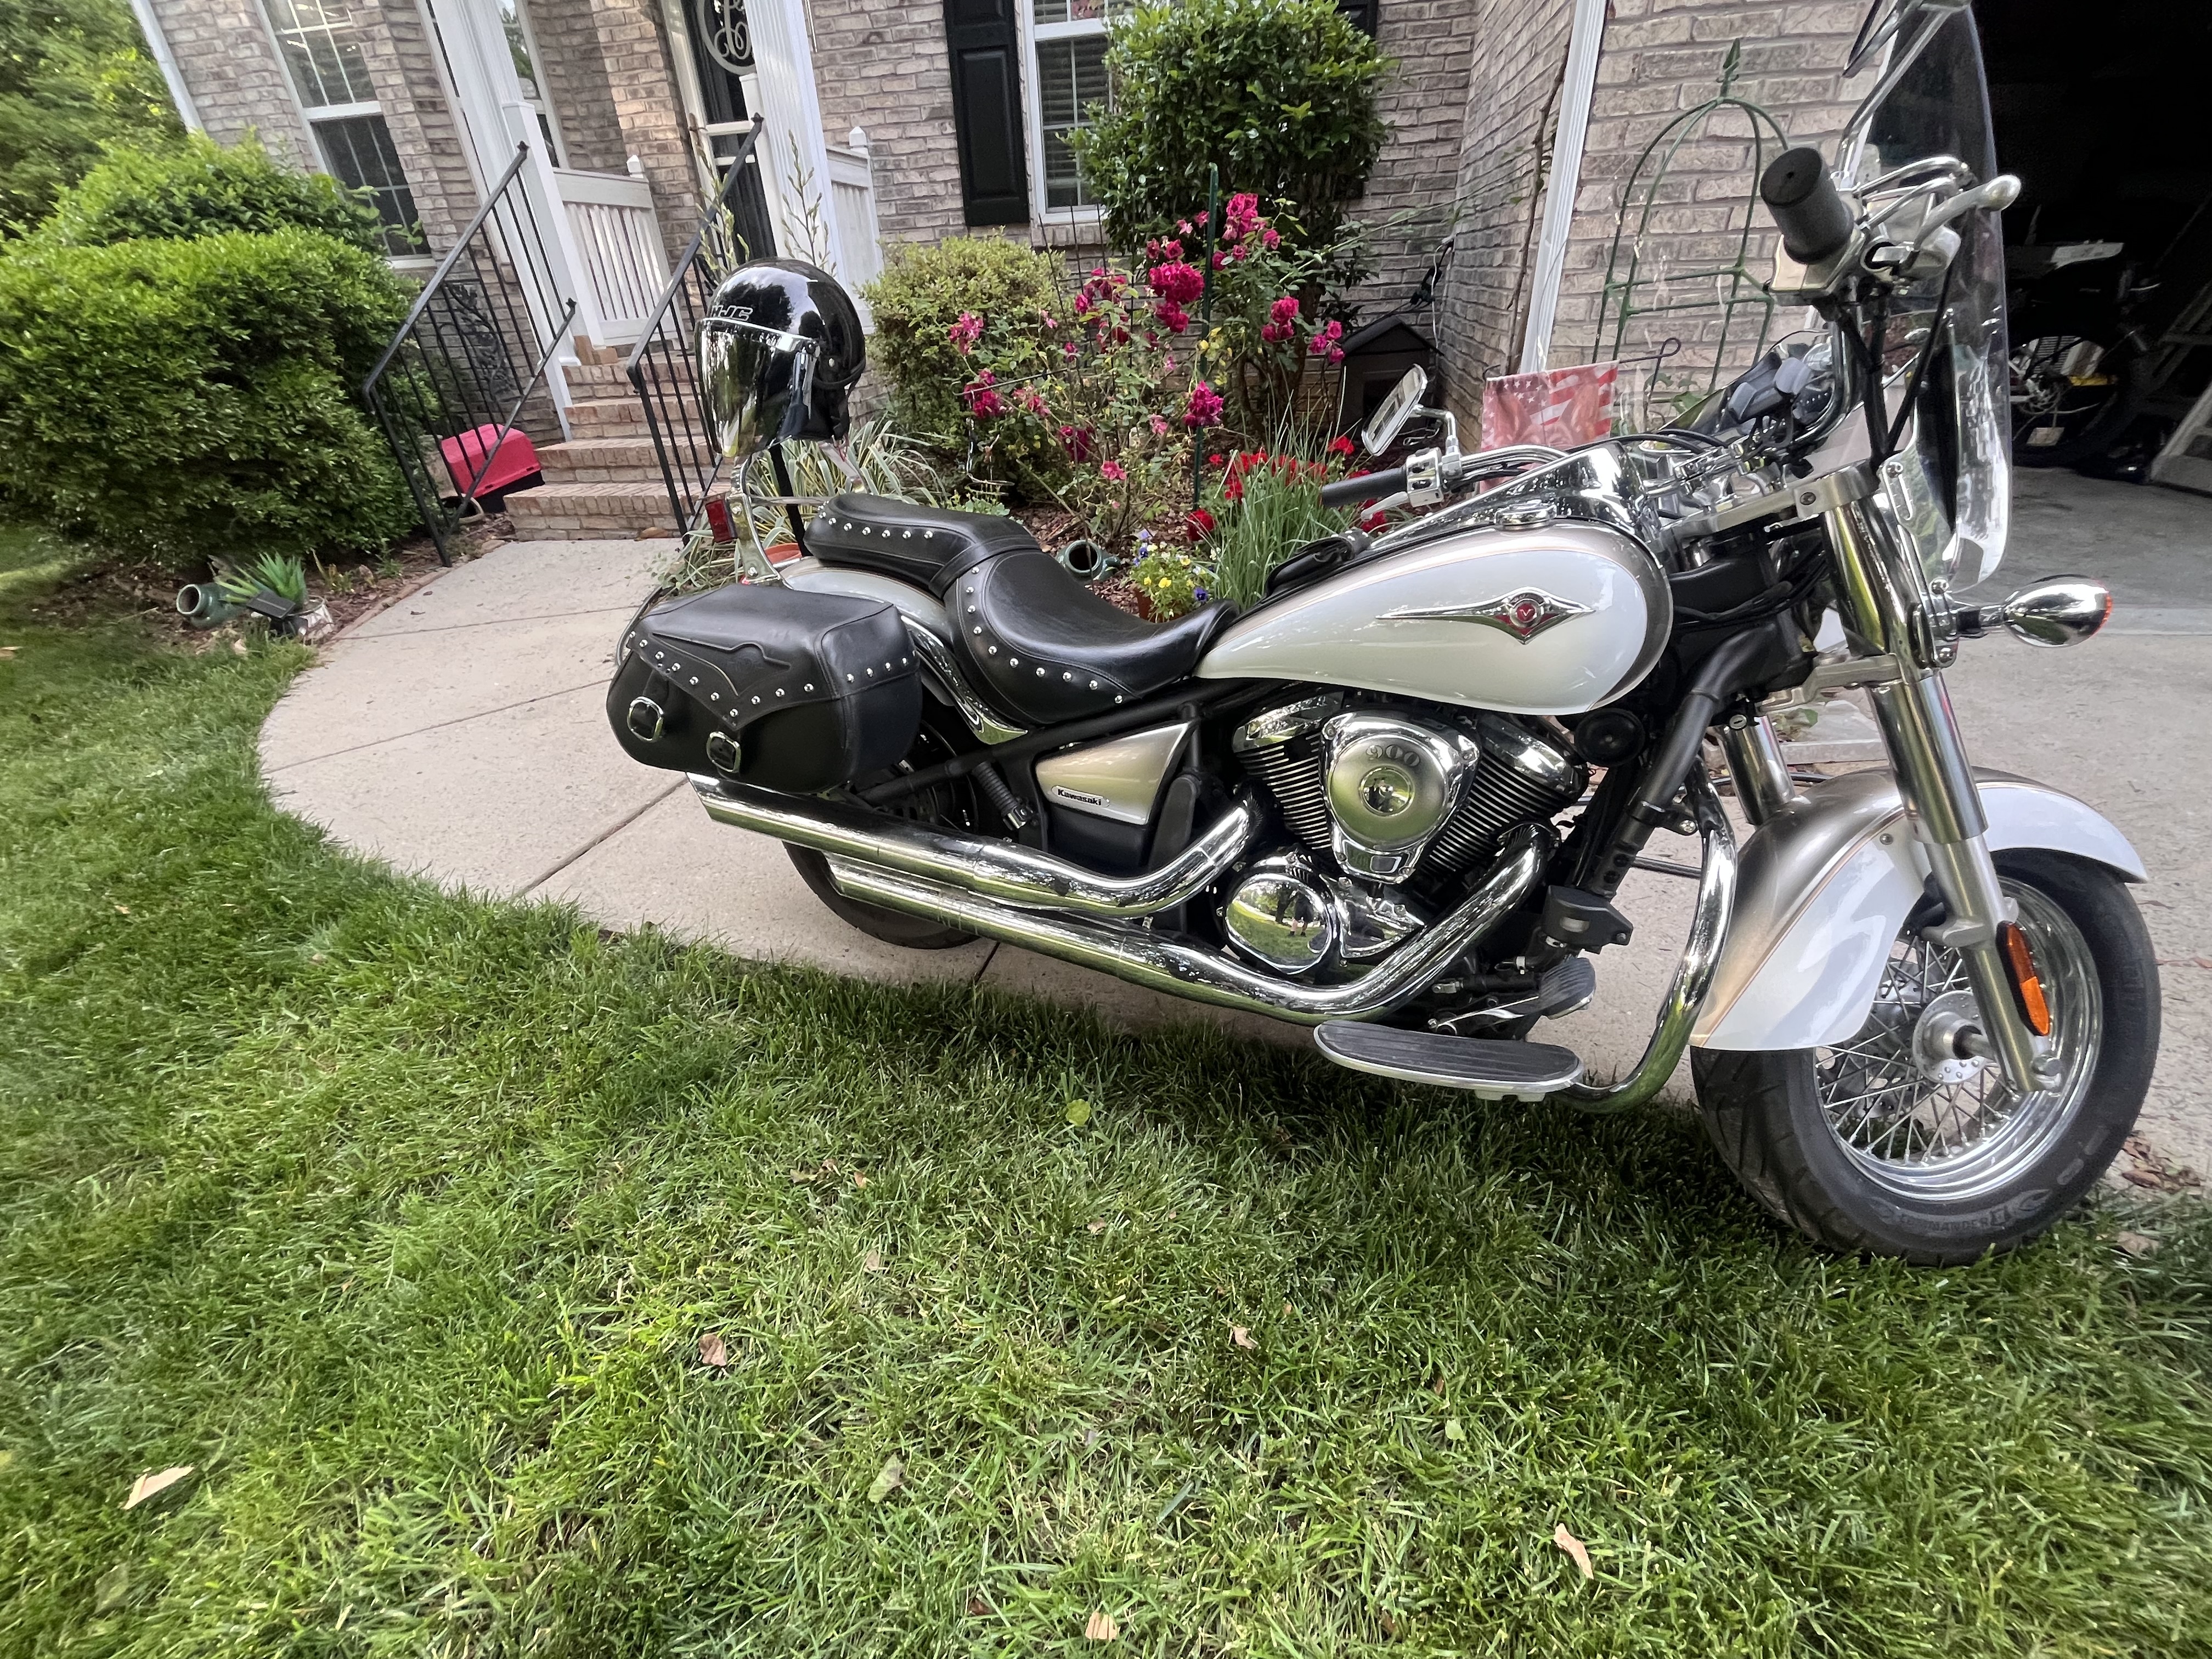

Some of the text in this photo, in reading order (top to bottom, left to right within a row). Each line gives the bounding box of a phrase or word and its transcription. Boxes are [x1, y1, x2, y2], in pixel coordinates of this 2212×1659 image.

[710, 304, 753, 321] HJC
[1365, 744, 1421, 768] 900
[1058, 788, 1102, 806] Kawasaki
